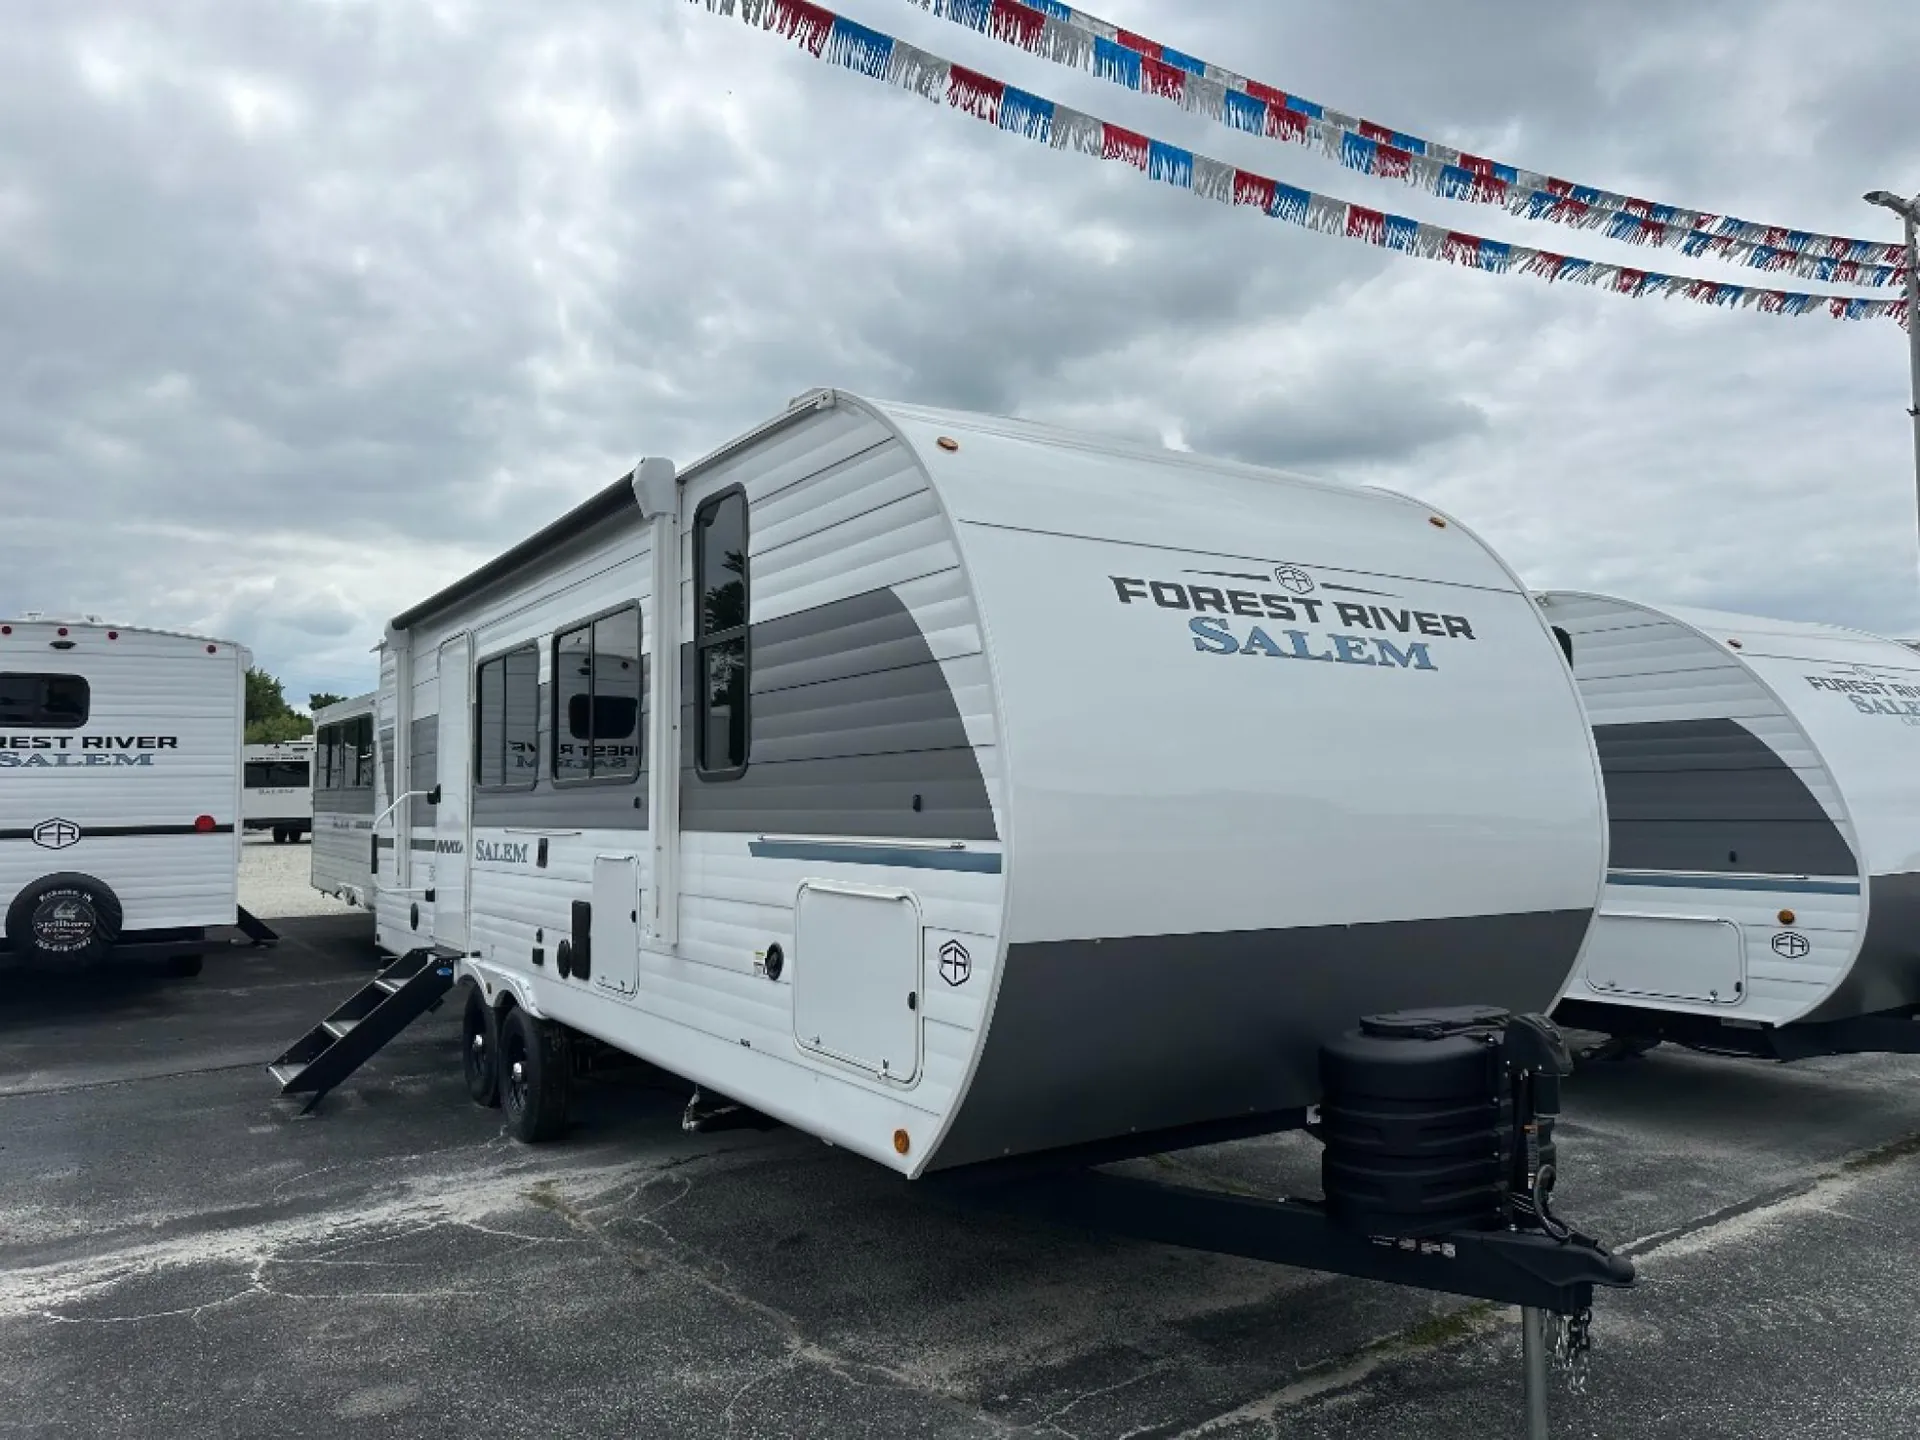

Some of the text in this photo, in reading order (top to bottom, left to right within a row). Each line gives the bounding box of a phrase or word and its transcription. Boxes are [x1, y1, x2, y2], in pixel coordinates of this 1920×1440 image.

[1108, 575, 1476, 640] FOREST RIVER
[1188, 616, 1439, 671] SALEM
[1804, 676, 1891, 696] FOREST
[82, 736, 178, 749] RIVER
[0, 751, 154, 767] SALEM
[475, 840, 529, 863] SALEM
